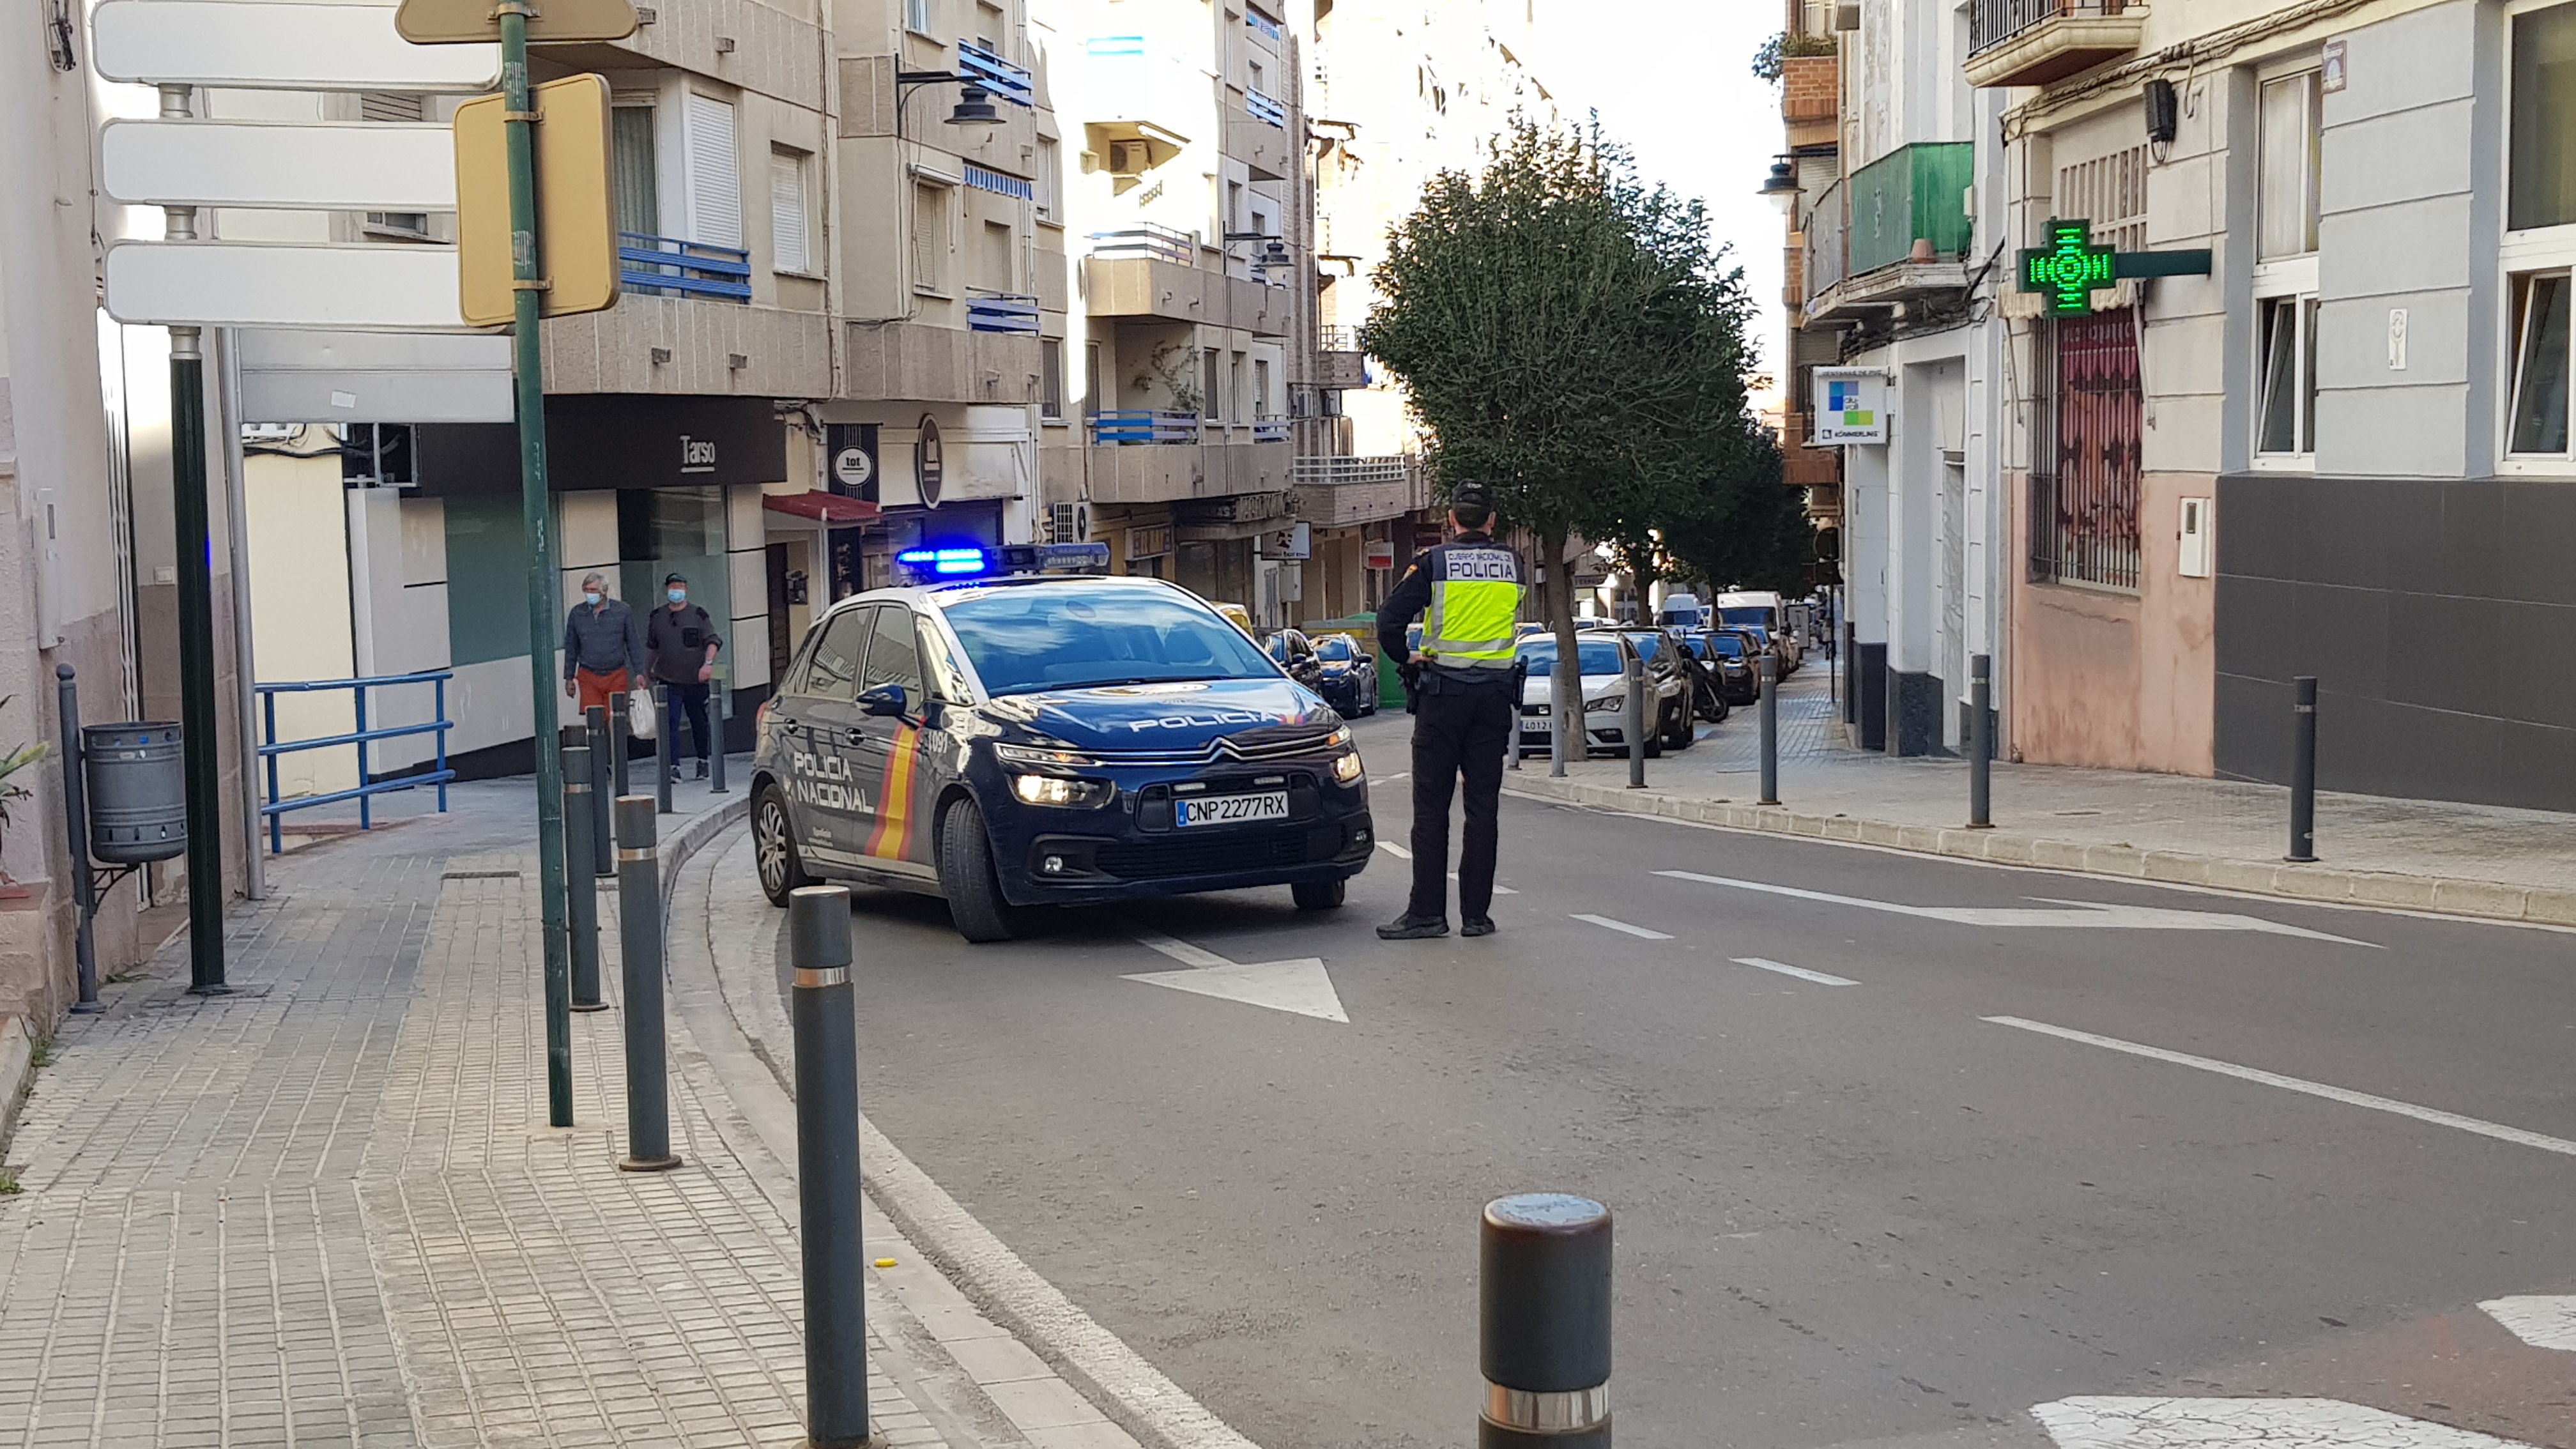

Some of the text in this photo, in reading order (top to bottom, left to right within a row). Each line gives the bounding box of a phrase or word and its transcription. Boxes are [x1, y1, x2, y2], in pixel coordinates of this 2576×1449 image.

[680, 435, 715, 464] Tarso
[846, 457, 861, 466] tot
[1449, 563, 1514, 578] POLICIA
[797, 779, 875, 814] NACIONAL
